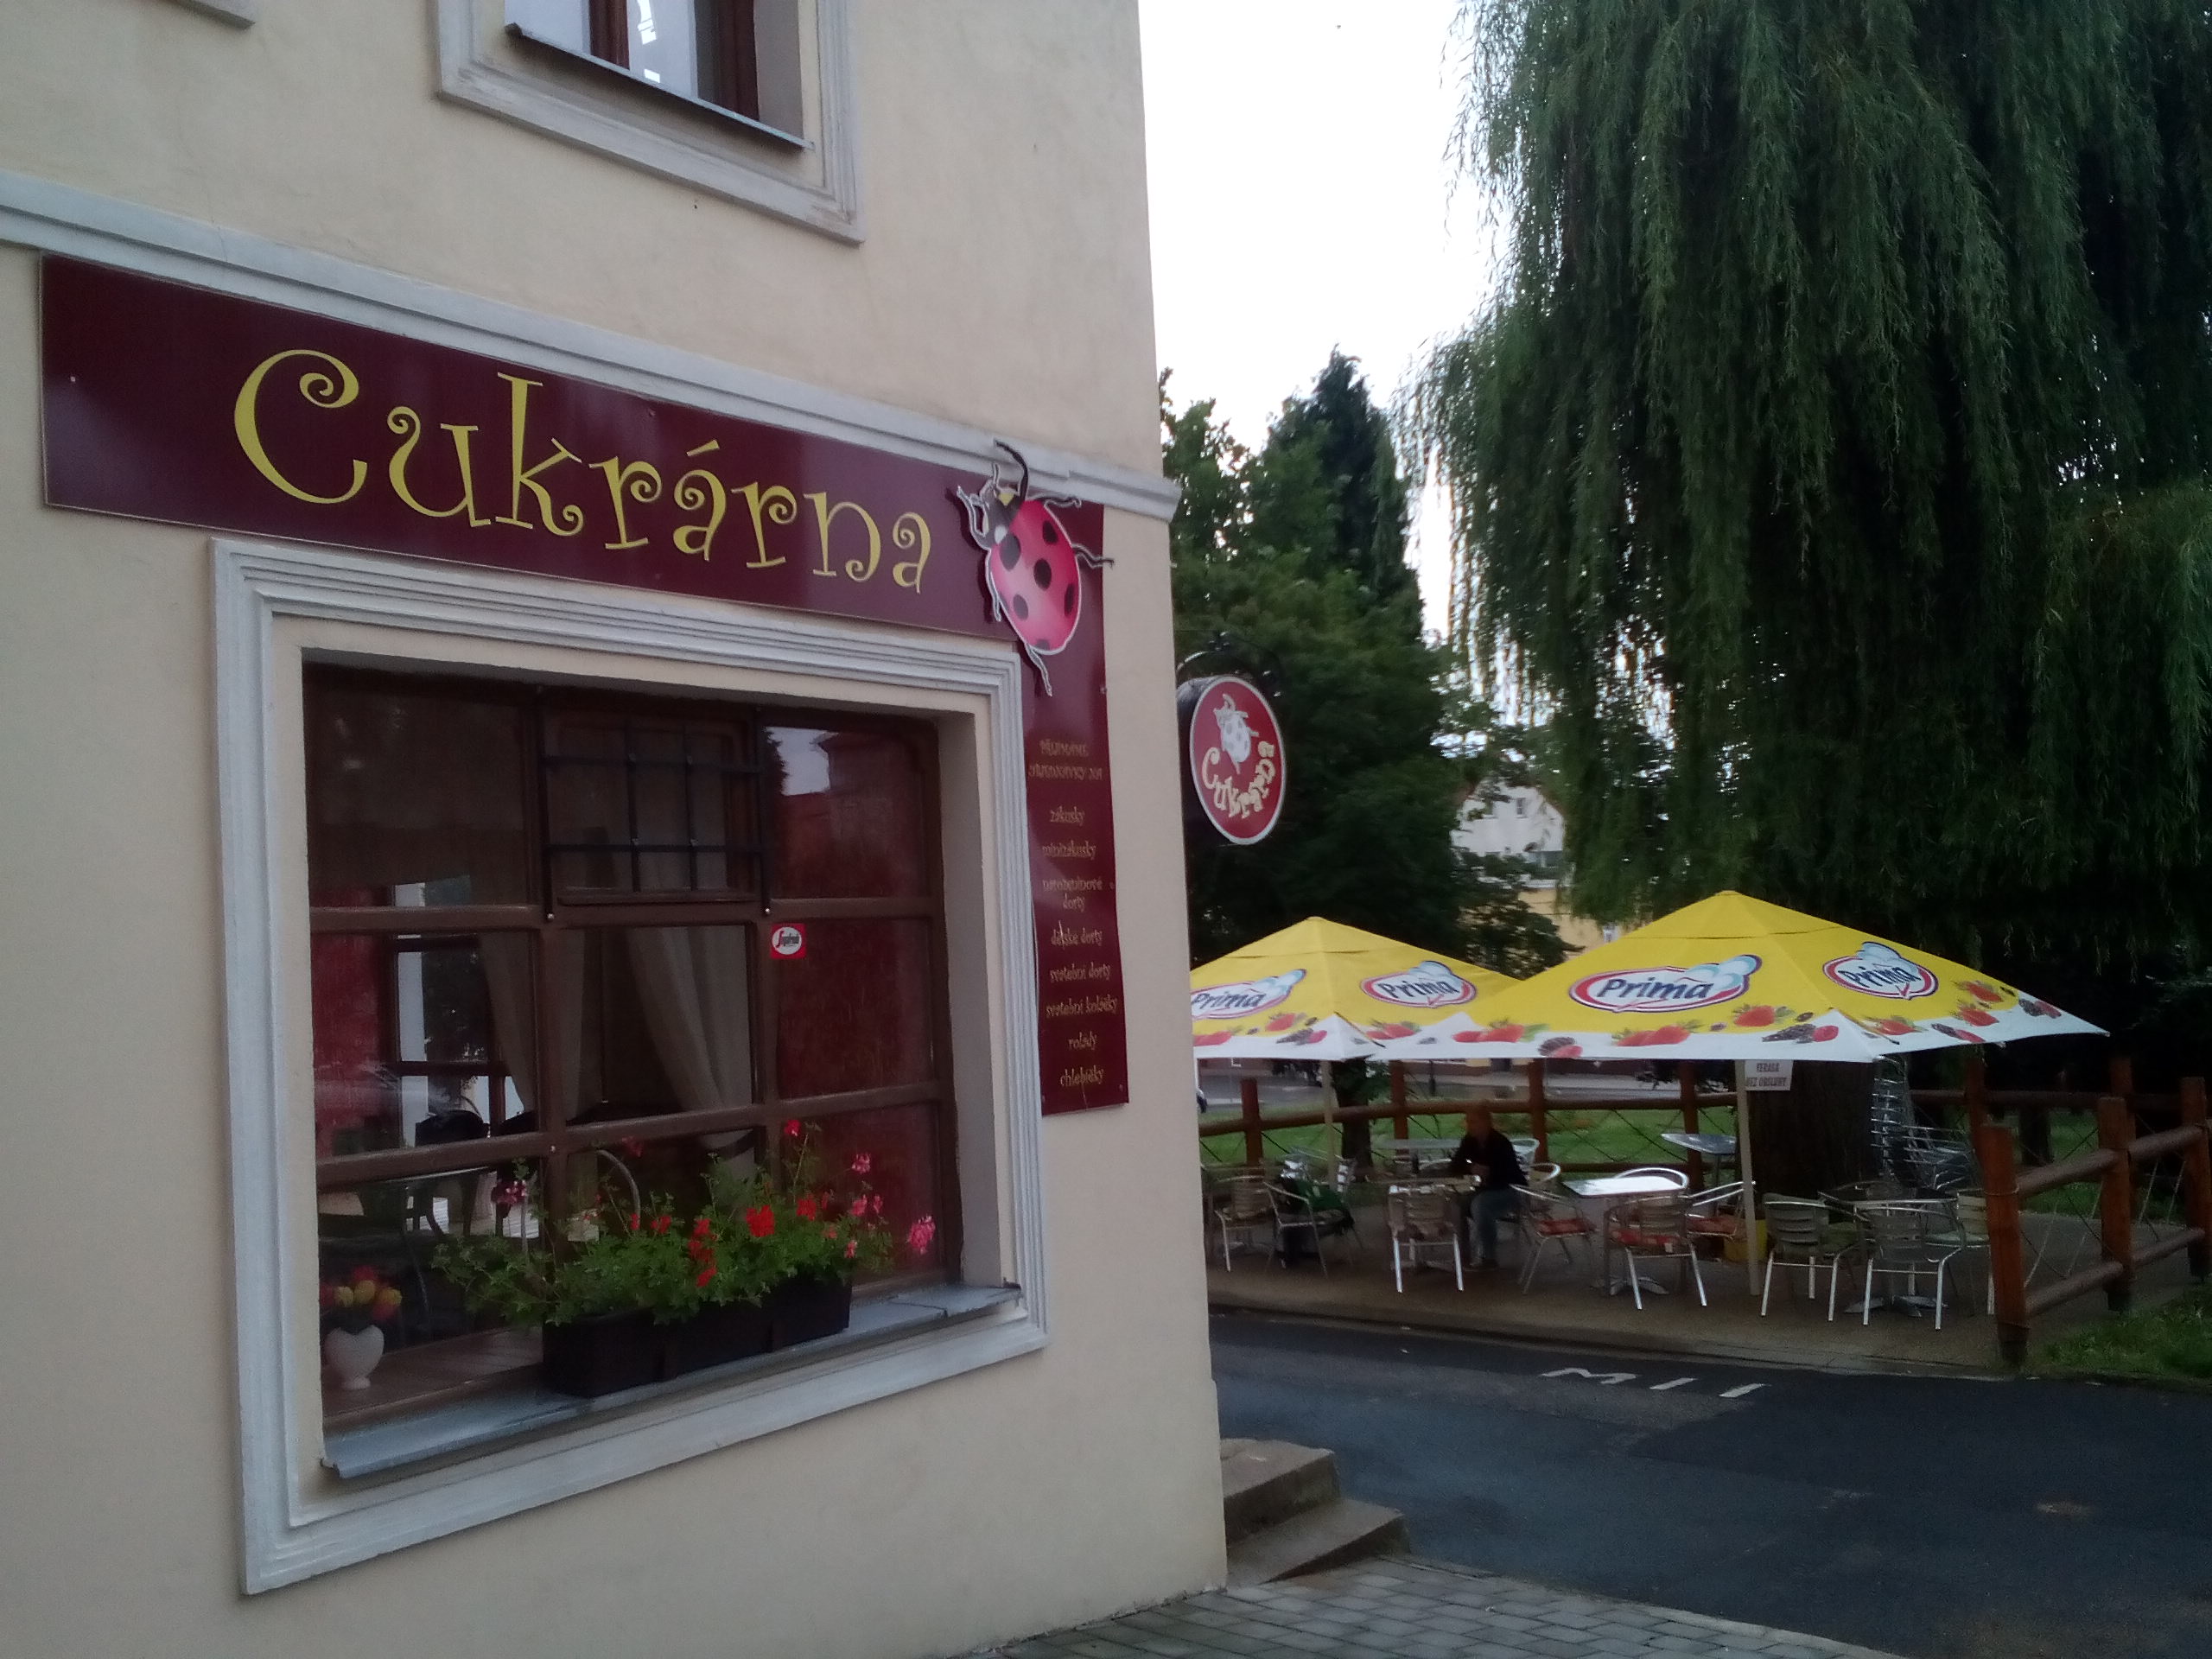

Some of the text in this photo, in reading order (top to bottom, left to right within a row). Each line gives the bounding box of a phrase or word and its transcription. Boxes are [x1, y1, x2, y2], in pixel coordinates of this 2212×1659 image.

[233, 349, 932, 594] Cukrárna
[1376, 980, 1460, 999] Prima
[1596, 976, 1714, 1000] Prima
[1191, 991, 1267, 1010] Prima
